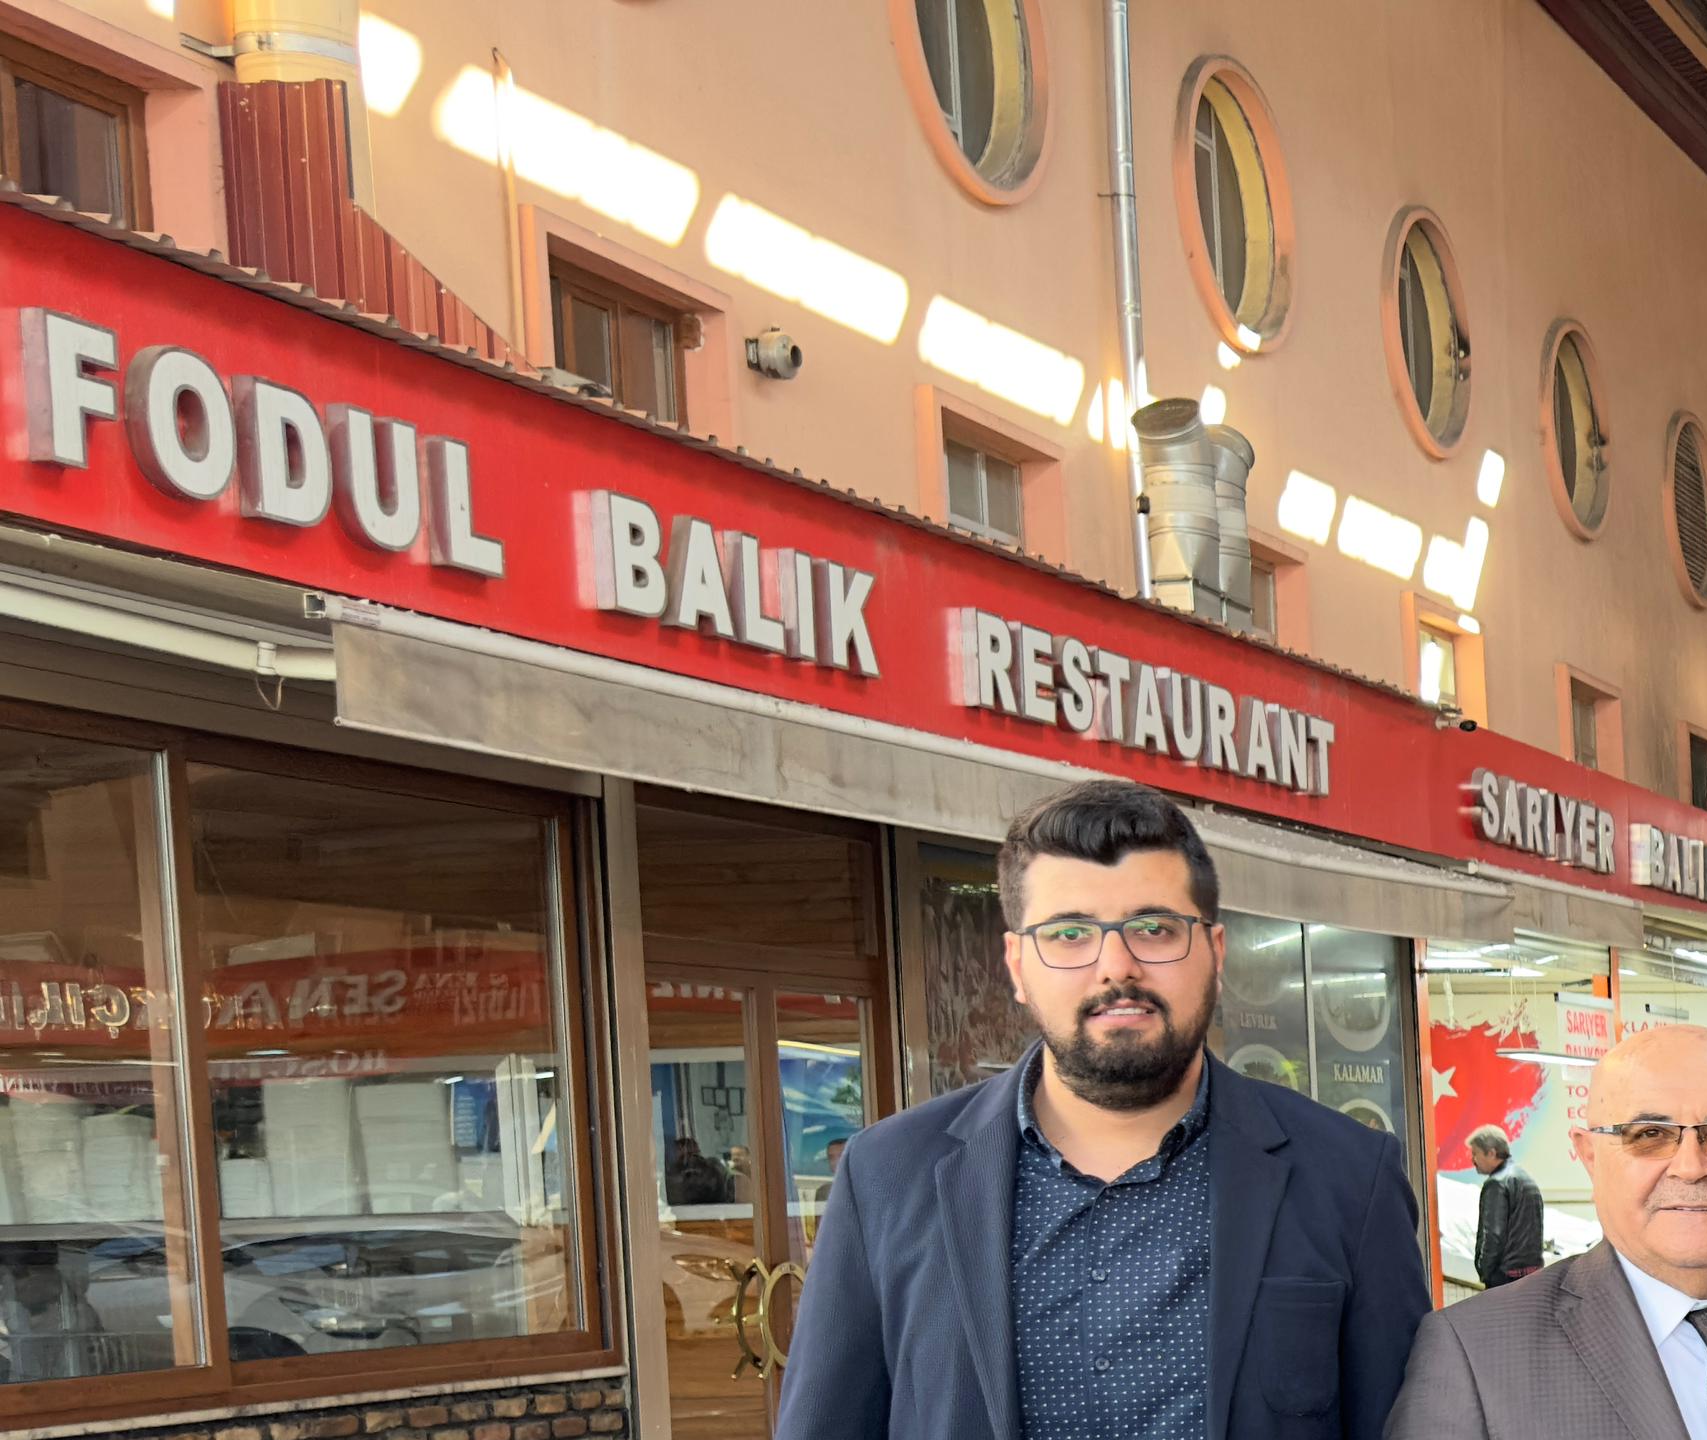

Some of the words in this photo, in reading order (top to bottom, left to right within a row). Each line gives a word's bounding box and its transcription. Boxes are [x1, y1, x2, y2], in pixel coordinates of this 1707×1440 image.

[20, 306, 506, 579] FODUL
[590, 489, 881, 678] BALIK
[960, 606, 1335, 797] RESTAURANT
[1471, 766, 1617, 875] SARIYER
[1333, 1063, 1385, 1084] KALAMAR
